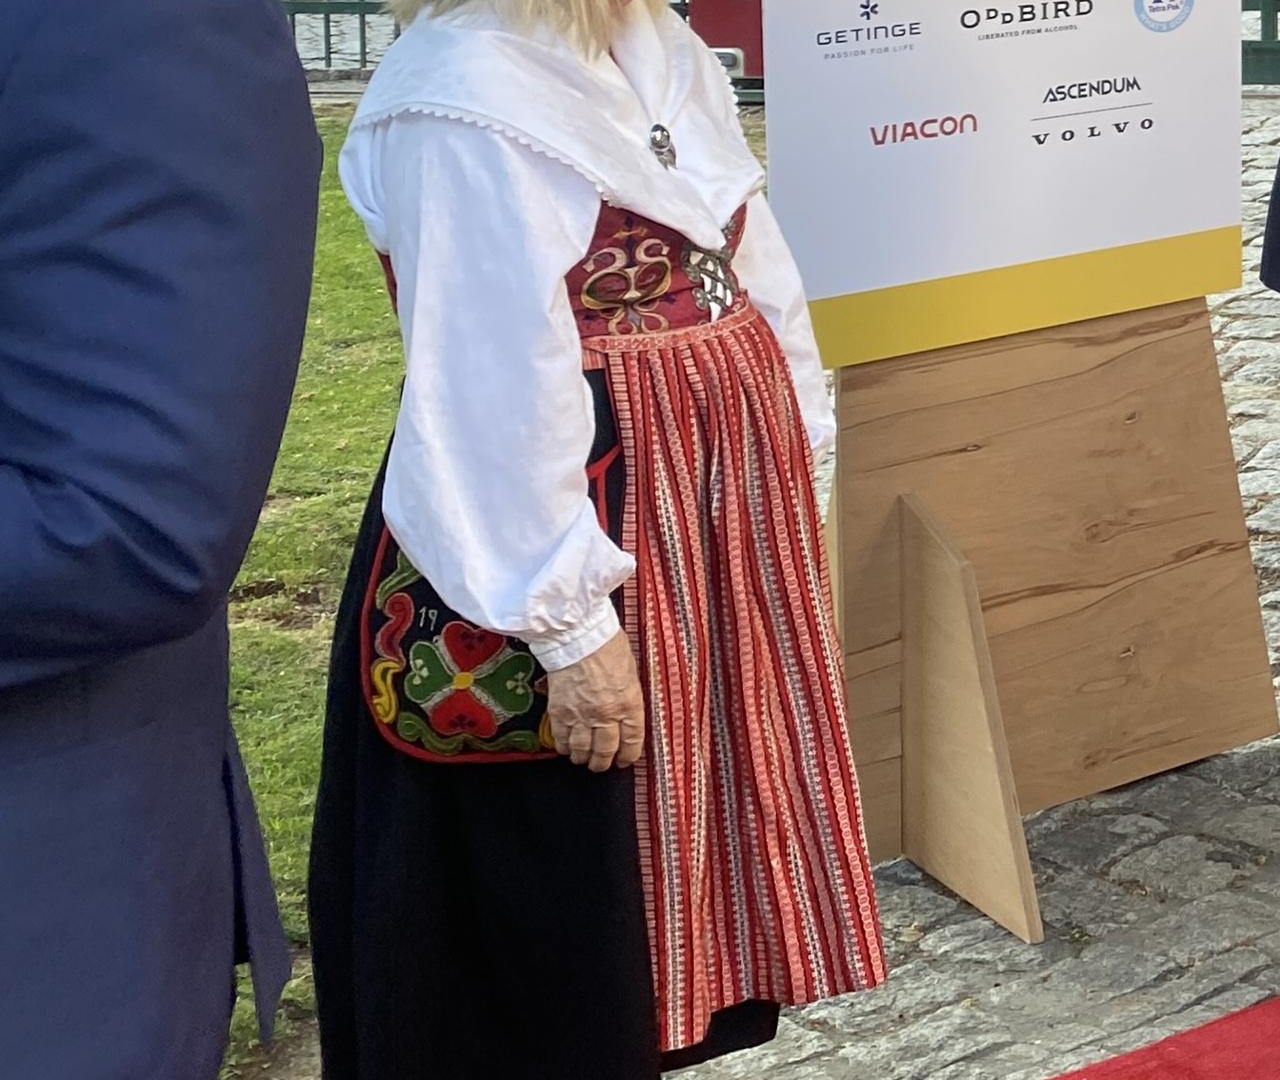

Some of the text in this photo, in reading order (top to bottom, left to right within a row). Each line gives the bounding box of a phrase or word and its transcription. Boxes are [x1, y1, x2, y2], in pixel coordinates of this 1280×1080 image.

[816, 22, 922, 46] GETINGE
[1042, 76, 1142, 104] ASCENDUM
[869, 113, 978, 146] VIACON
[1031, 117, 1154, 146] VOLVO
[418, 606, 438, 632] 19
